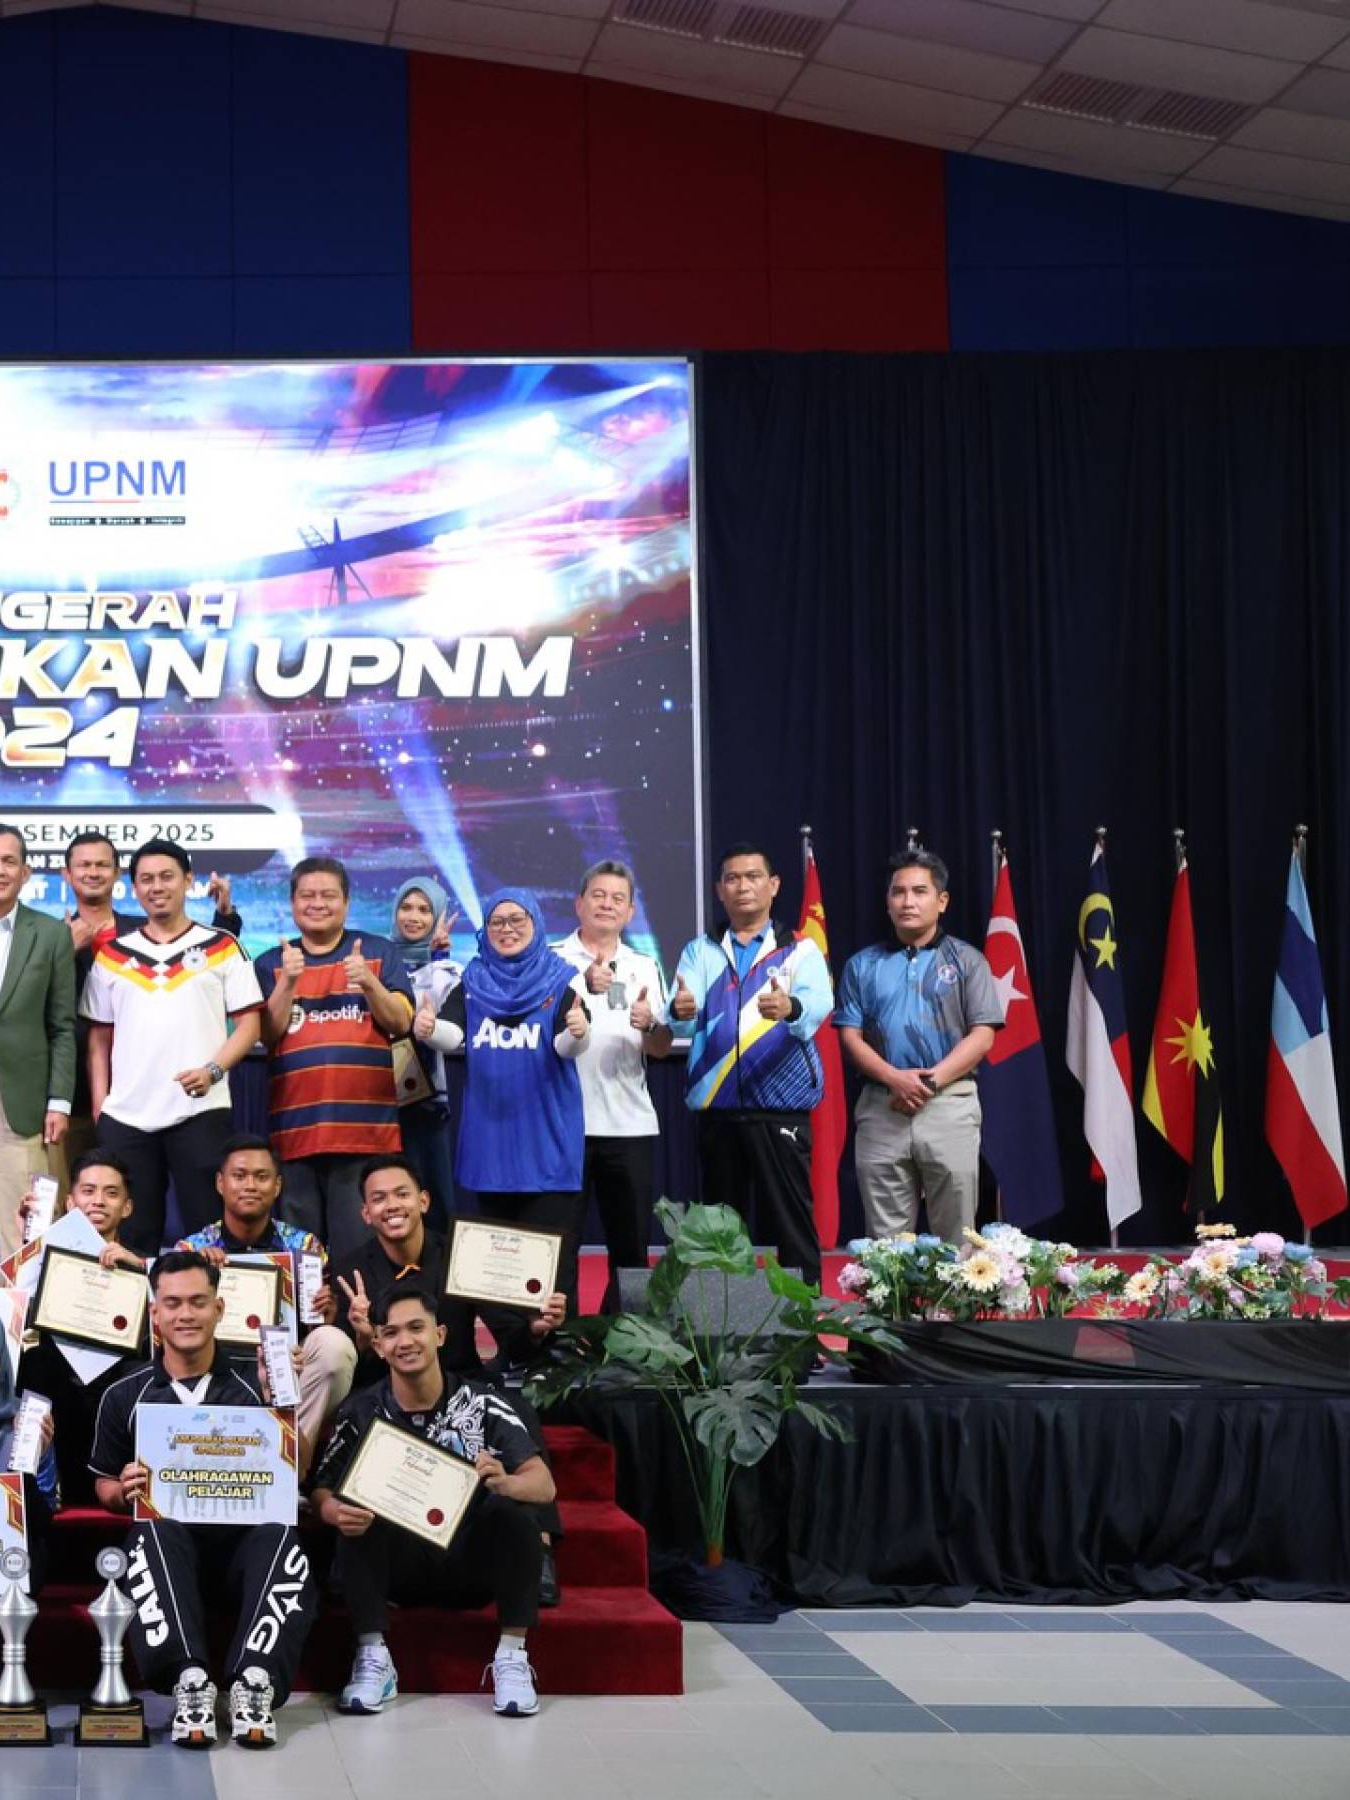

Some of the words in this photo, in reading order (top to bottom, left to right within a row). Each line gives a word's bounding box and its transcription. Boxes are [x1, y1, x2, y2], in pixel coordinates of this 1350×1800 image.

[49, 460, 186, 497] UPNM
[250, 636, 575, 699] UPNM
[150, 823, 215, 842] 2025
[160, 1469, 273, 1484] OLAHRAGAWAN
[187, 1484, 253, 1498] PELAJAR
